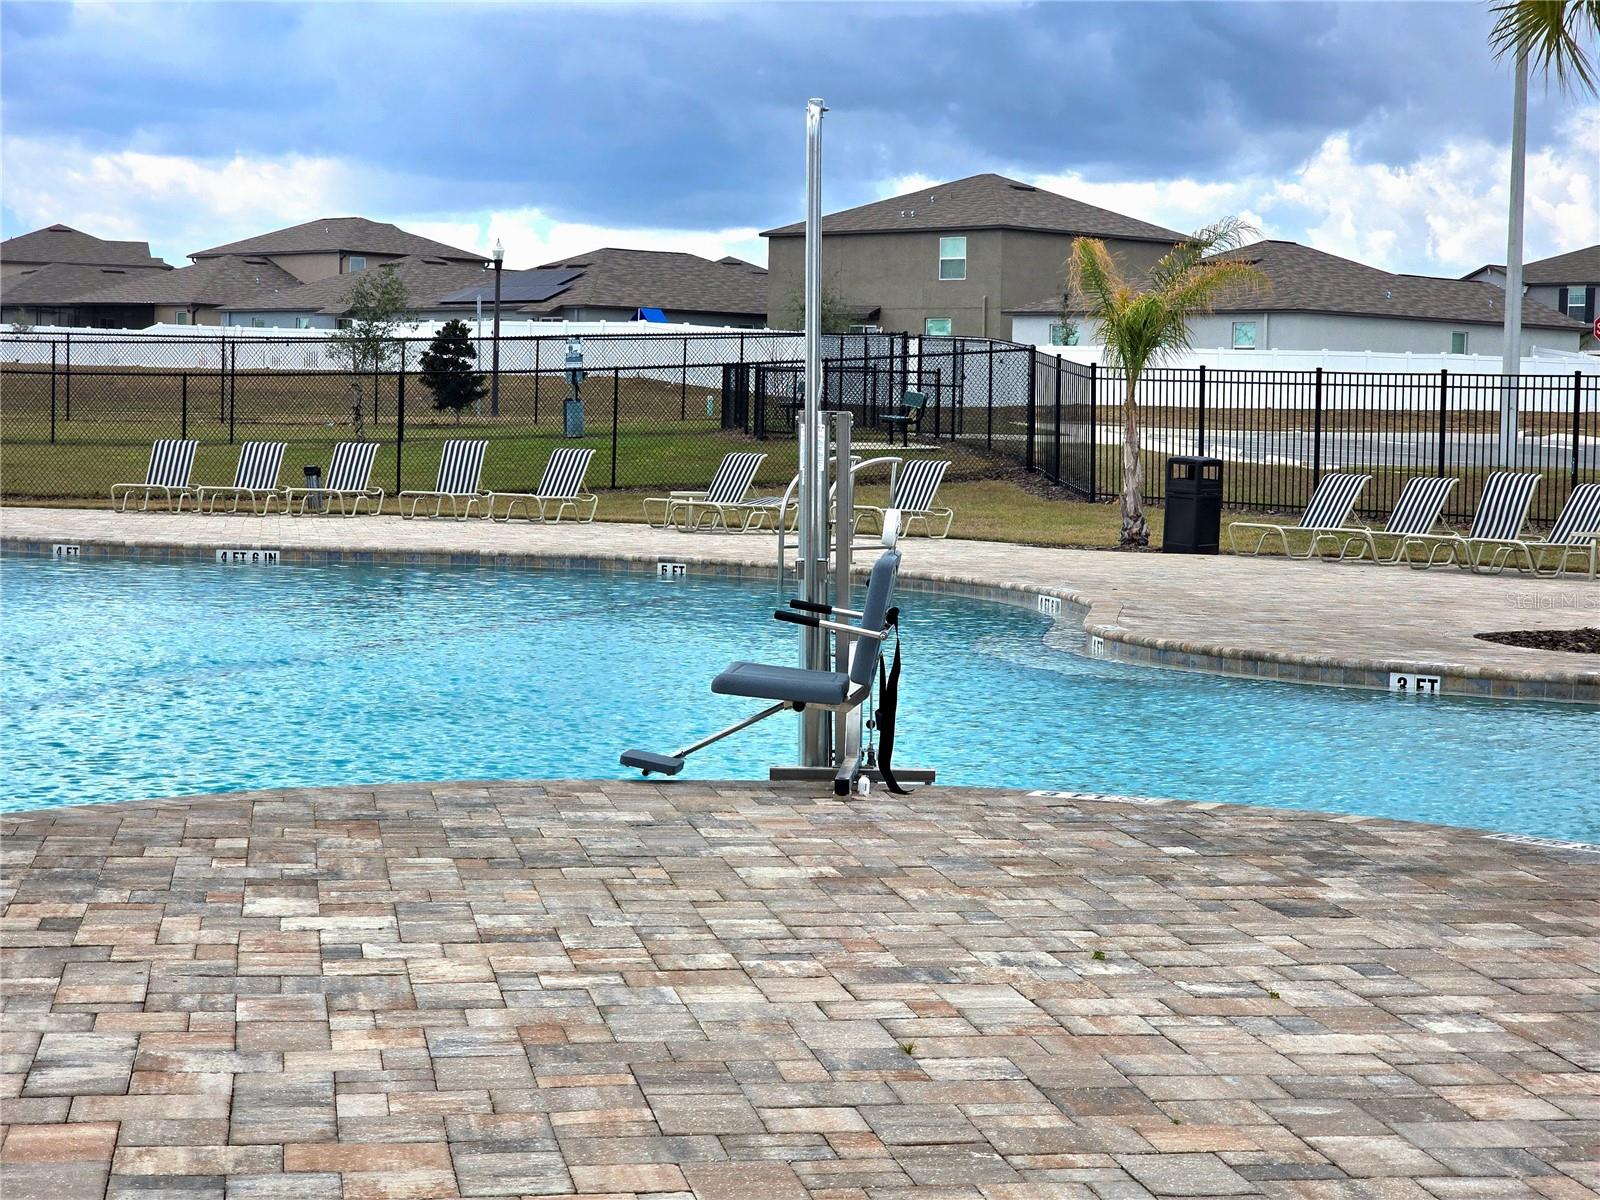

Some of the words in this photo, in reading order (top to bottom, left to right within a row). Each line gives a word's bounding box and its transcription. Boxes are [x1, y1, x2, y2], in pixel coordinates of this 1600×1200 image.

[66, 546, 79, 555] FT
[220, 551, 227, 562] 4
[232, 552, 247, 562] FT
[264, 552, 277, 562] IN
[672, 565, 685, 576] FT
[1397, 676, 1408, 690] 3
[1416, 677, 1439, 693] FT
